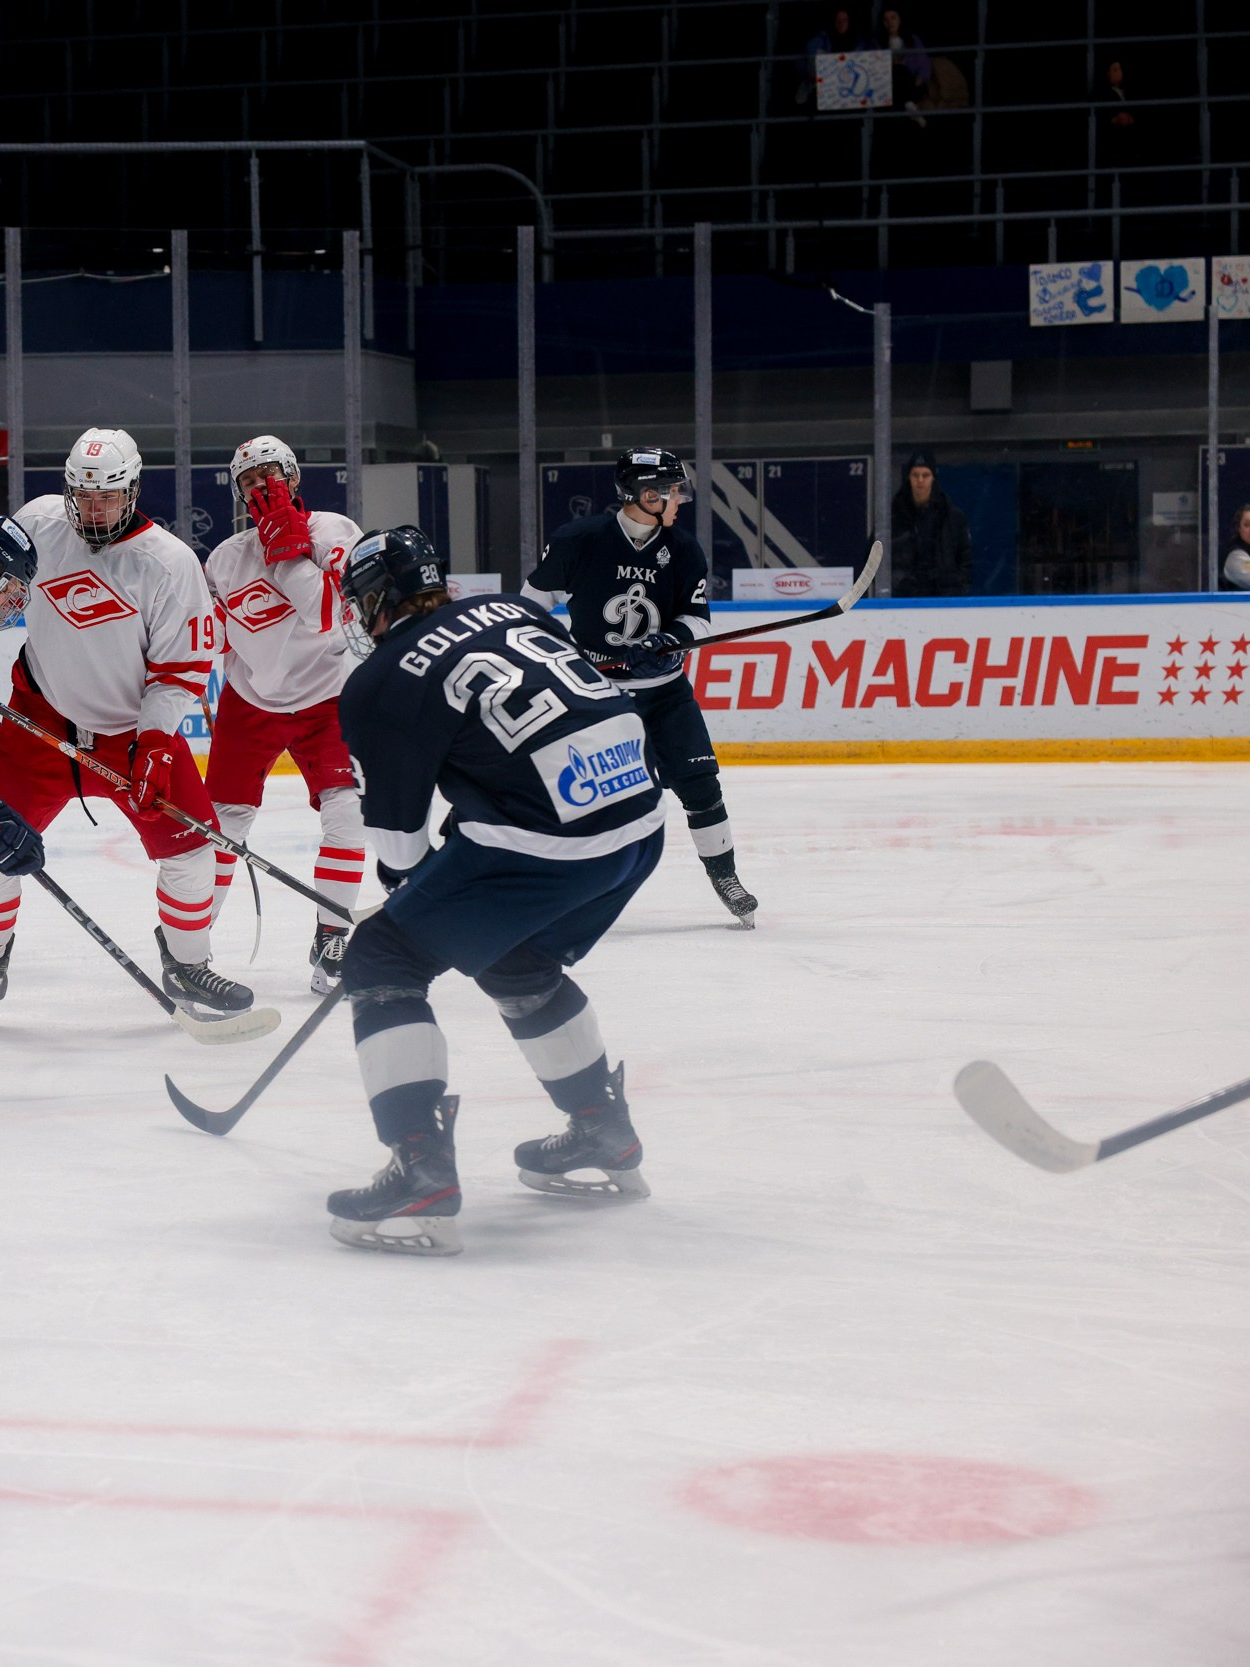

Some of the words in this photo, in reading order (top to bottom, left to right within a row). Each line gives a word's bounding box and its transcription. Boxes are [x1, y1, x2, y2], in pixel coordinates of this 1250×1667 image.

[86, 442, 103, 457] 19
[215, 471, 229, 485] 10
[768, 465, 781, 478] 21
[850, 462, 865, 476] 22
[419, 563, 440, 585] 28
[616, 565, 658, 584] МХК
[774, 580, 811, 588] SINTEC
[188, 613, 214, 651] 19
[685, 641, 791, 710] ED
[801, 634, 1149, 710] MACHINE
[442, 624, 622, 754] 28
[66, 900, 132, 966] CCM
